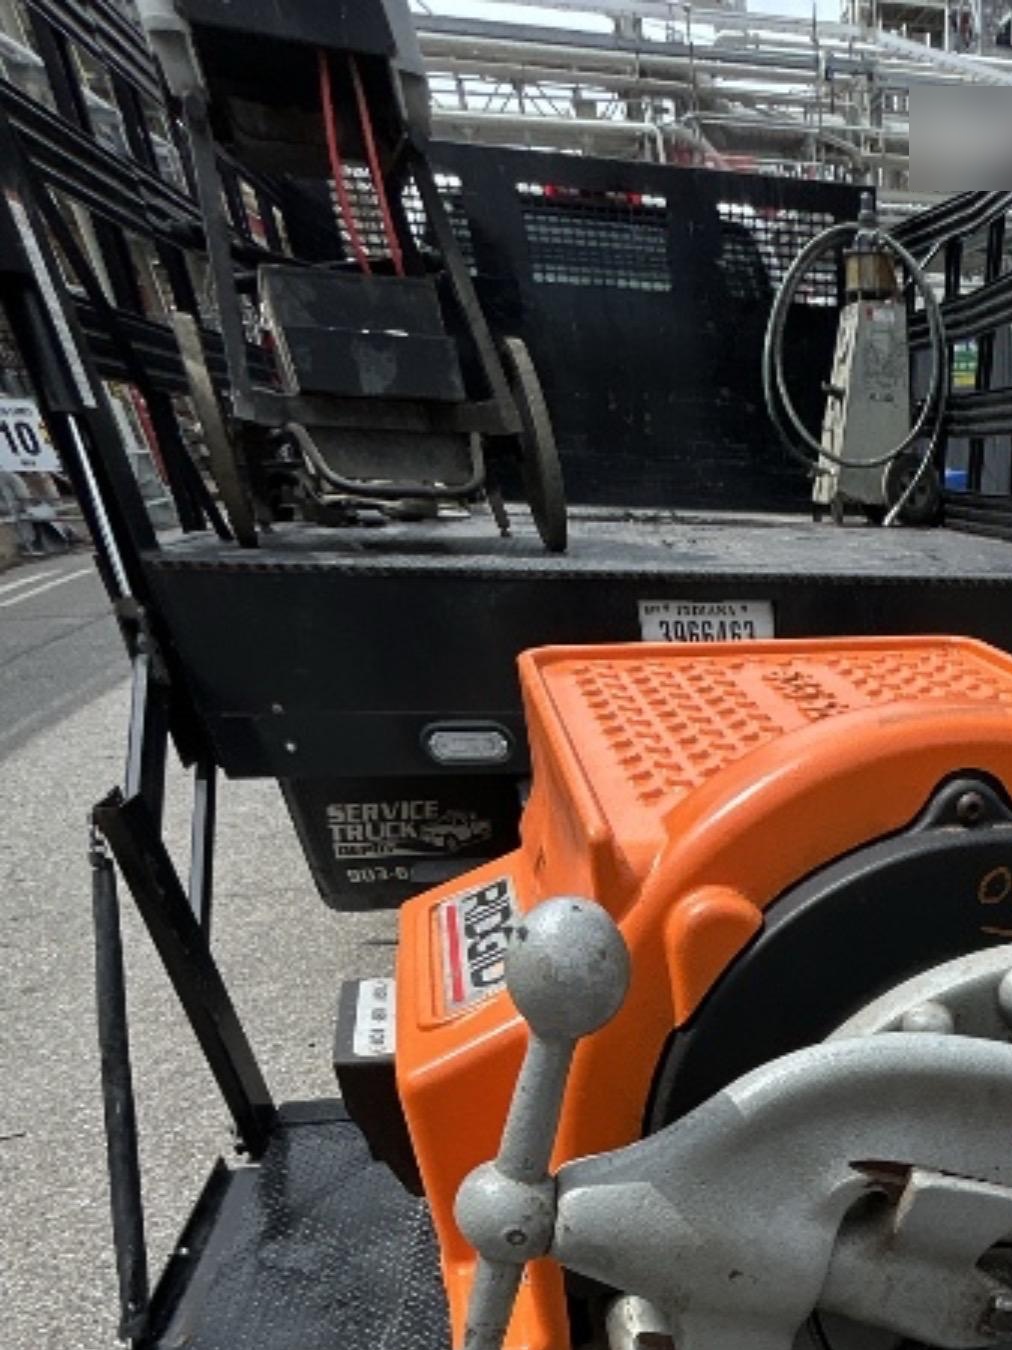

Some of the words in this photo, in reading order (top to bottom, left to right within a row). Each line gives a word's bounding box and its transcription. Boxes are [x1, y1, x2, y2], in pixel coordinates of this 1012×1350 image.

[0, 421, 41, 456] 10
[326, 800, 439, 823] SERVICE
[328, 822, 418, 842] TRUCK
